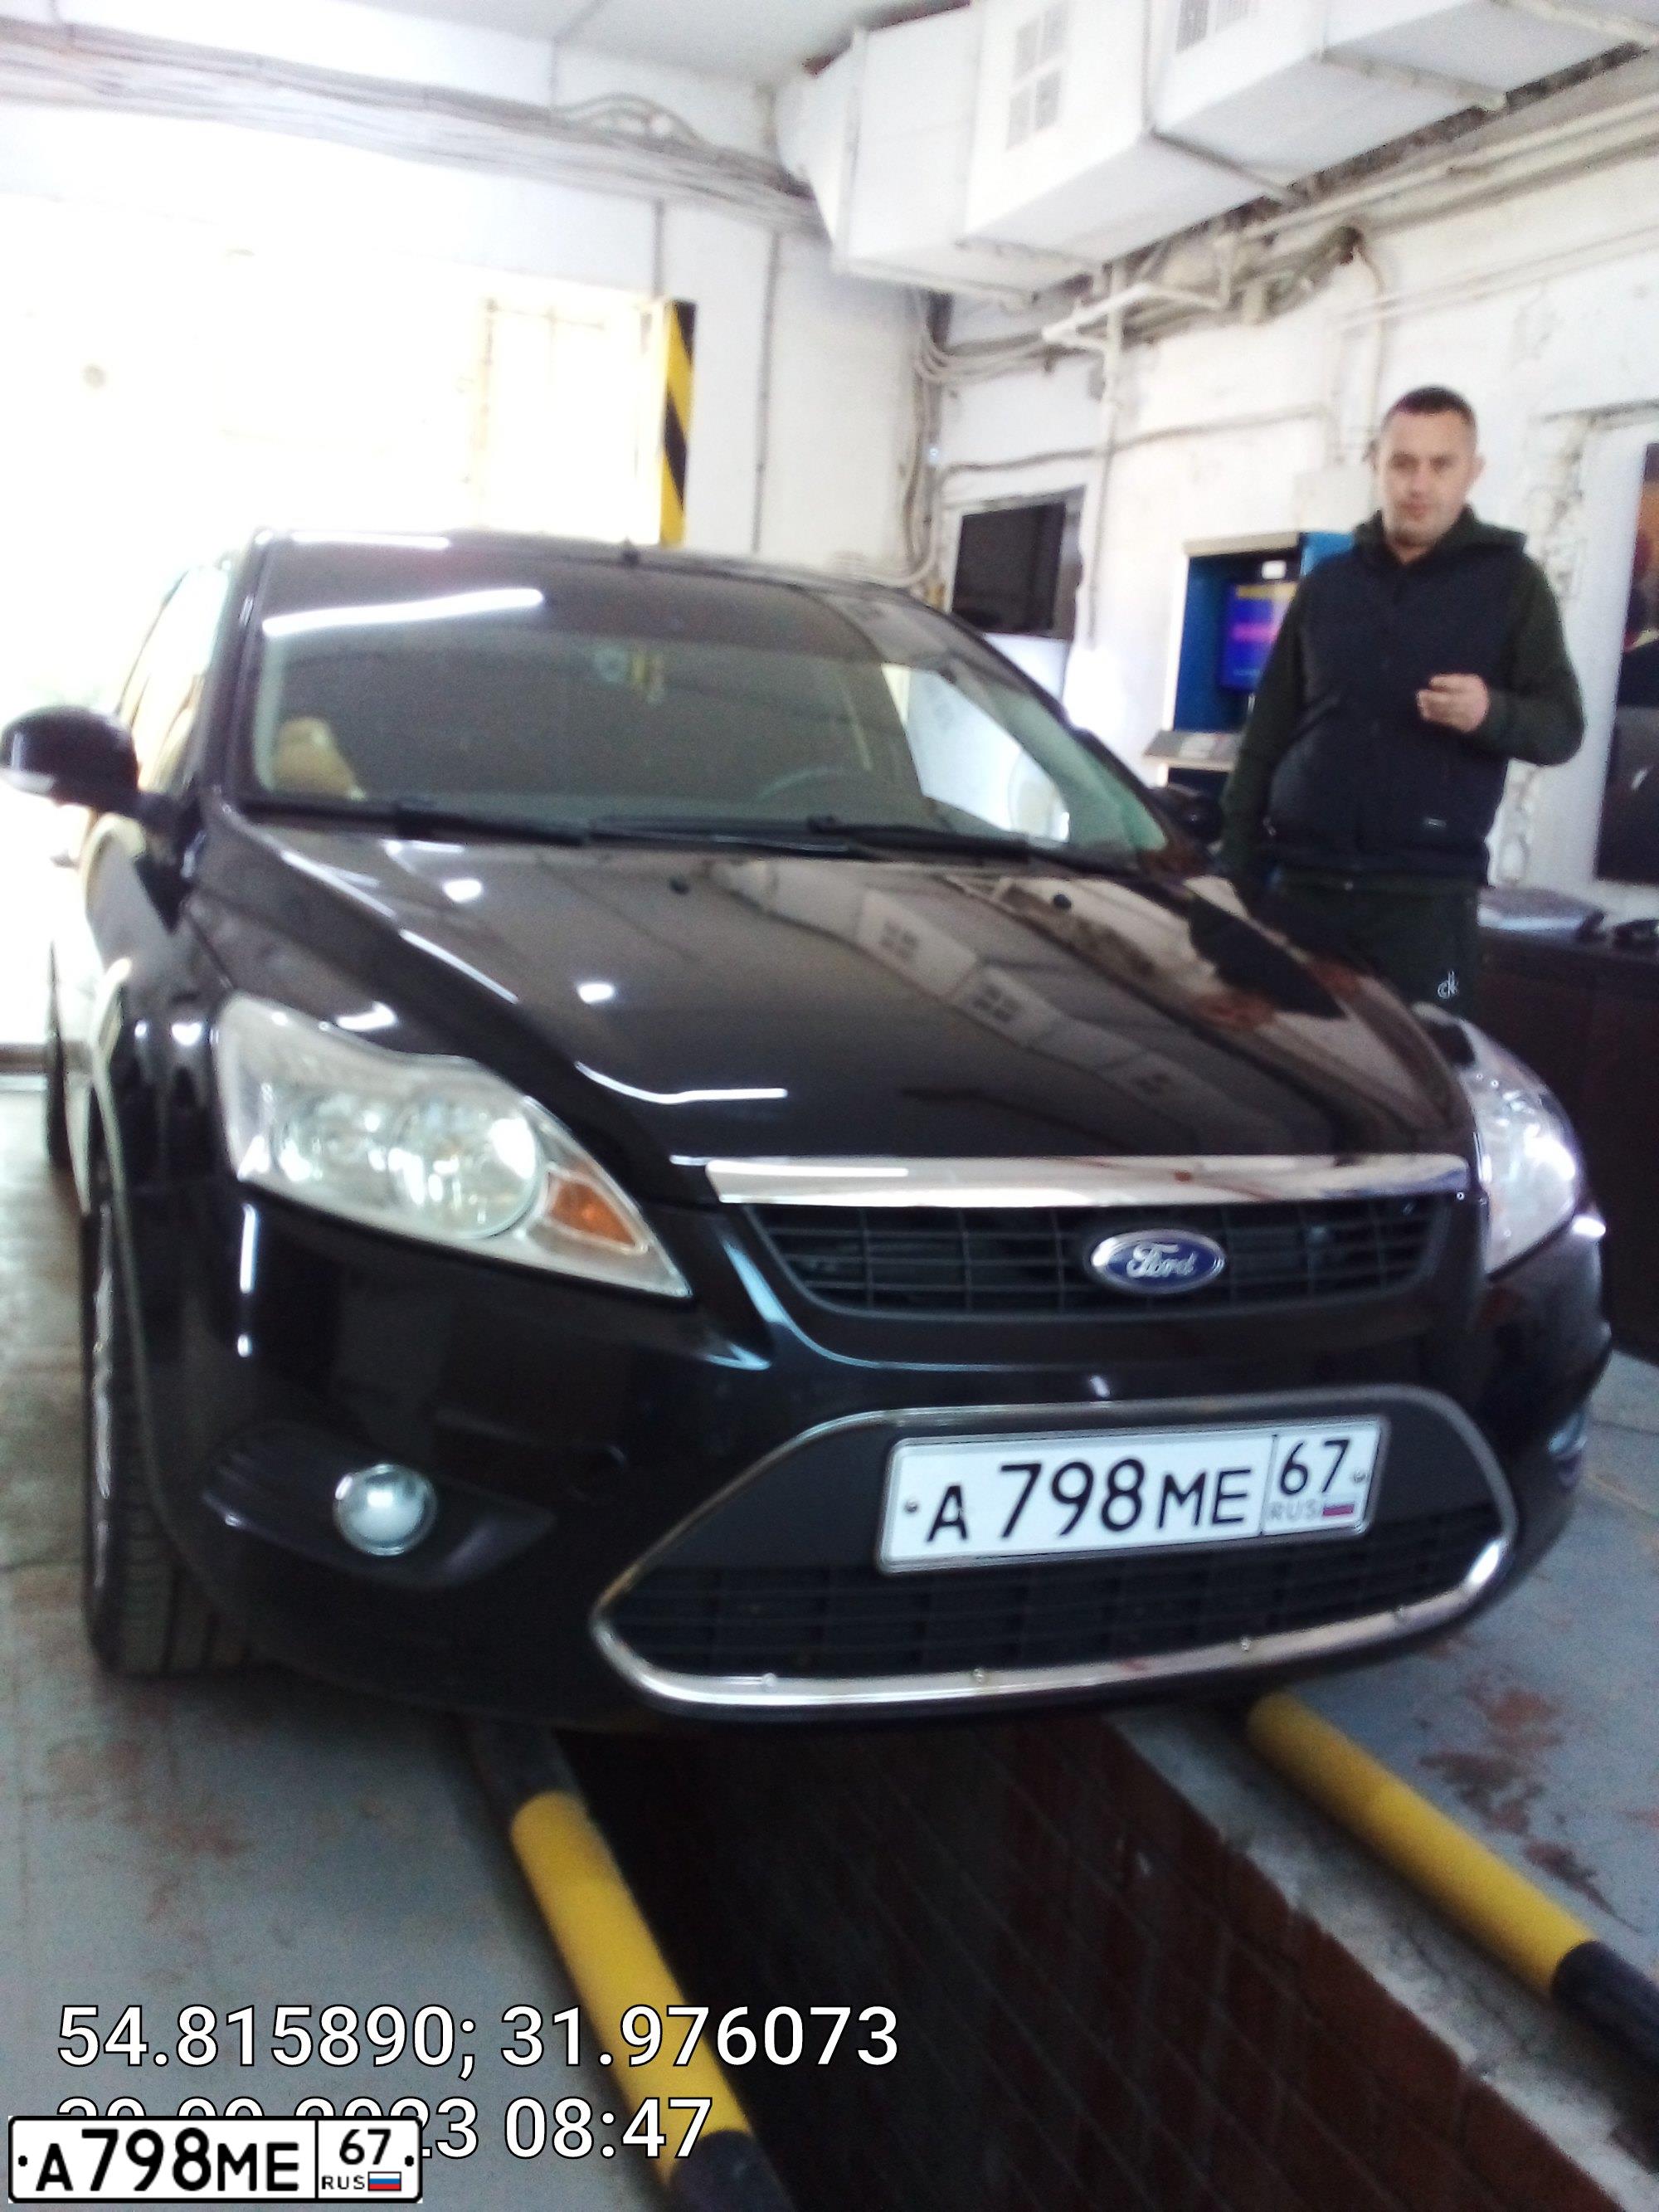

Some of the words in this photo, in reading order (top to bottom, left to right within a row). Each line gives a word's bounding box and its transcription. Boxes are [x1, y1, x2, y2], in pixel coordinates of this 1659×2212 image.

[1126, 1243, 1198, 1279] Ford
[1280, 1438, 1350, 1495] 67
[1266, 1498, 1317, 1520] RUS
